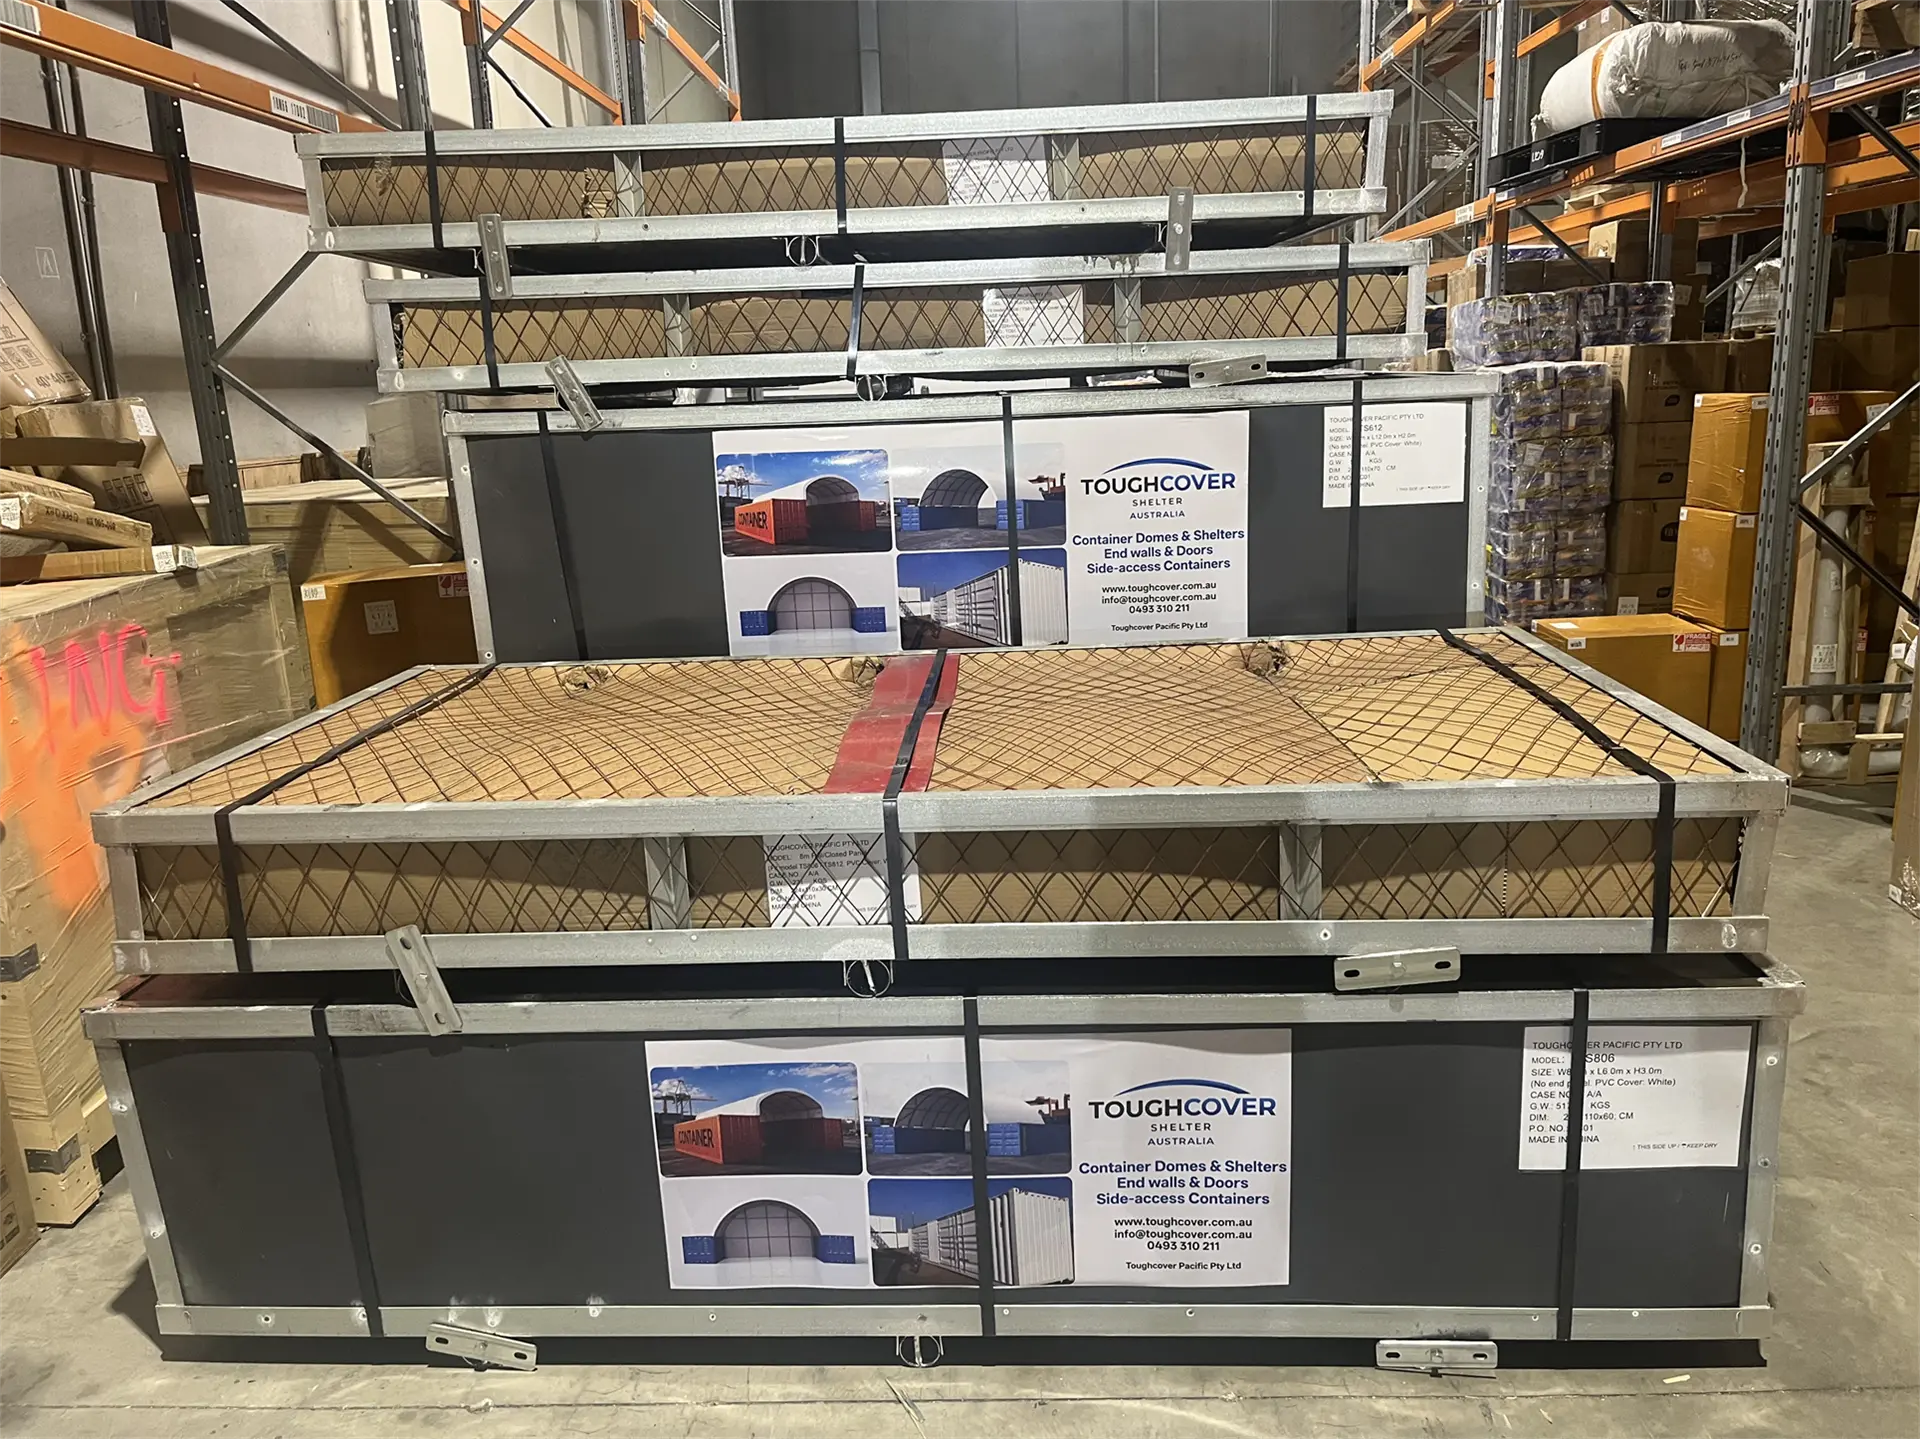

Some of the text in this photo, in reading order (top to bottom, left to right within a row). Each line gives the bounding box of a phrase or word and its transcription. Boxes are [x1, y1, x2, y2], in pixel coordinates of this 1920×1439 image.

[1081, 472, 1236, 495] TOUGHCOVER
[1132, 497, 1183, 507] SHELTER
[738, 511, 768, 530] CONTAINER
[1130, 510, 1186, 520] AUSTRALIA
[1072, 529, 1245, 546] Container Domes & Shelters
[1104, 545, 1214, 560] End walls & Doors
[1087, 559, 1231, 574] Side-access Containers
[1102, 582, 1217, 594] www.toughcover.com.au
[1102, 592, 1217, 604] info@toughcover.com.au
[1129, 604, 1190, 614] 0493 310 211
[1112, 622, 1208, 632] Toughcover Pacific Pty Ltd
[1532, 1040, 1683, 1050] TOUGHCER PACIFIC PTY LTD
[1531, 1056, 1564, 1064] MODEL:
[1530, 1080, 1546, 1089] (No
[1548, 1080, 1565, 1088] end
[1594, 1078, 1616, 1086] PVC
[1617, 1078, 1645, 1086] Cover:
[1648, 1078, 1676, 1087] White)
[1530, 1091, 1556, 1099] CASE
[1586, 1090, 1602, 1098] A/A
[1088, 1098, 1276, 1119] TOUGHCOVER
[1590, 1101, 1611, 1110] KGS
[1618, 1112, 1634, 1120] CM
[1150, 1122, 1212, 1132] SHELTER
[678, 1128, 714, 1148] CONTAINER
[1147, 1136, 1215, 1146] AUSTRALIA
[1528, 1135, 1556, 1144] MADE
[1078, 1160, 1288, 1174] Container Domes & Shelters
[1116, 1176, 1249, 1188] End walls & Doors
[1096, 1192, 1270, 1204] Side-access Containers
[1114, 1217, 1252, 1228] www.toughcover.com.au
[1114, 1229, 1252, 1240] info@toughcover.com.au
[1147, 1240, 1220, 1250] 0493 310 211
[1126, 1262, 1242, 1271] Toughcover Pacific Pty Ltd
